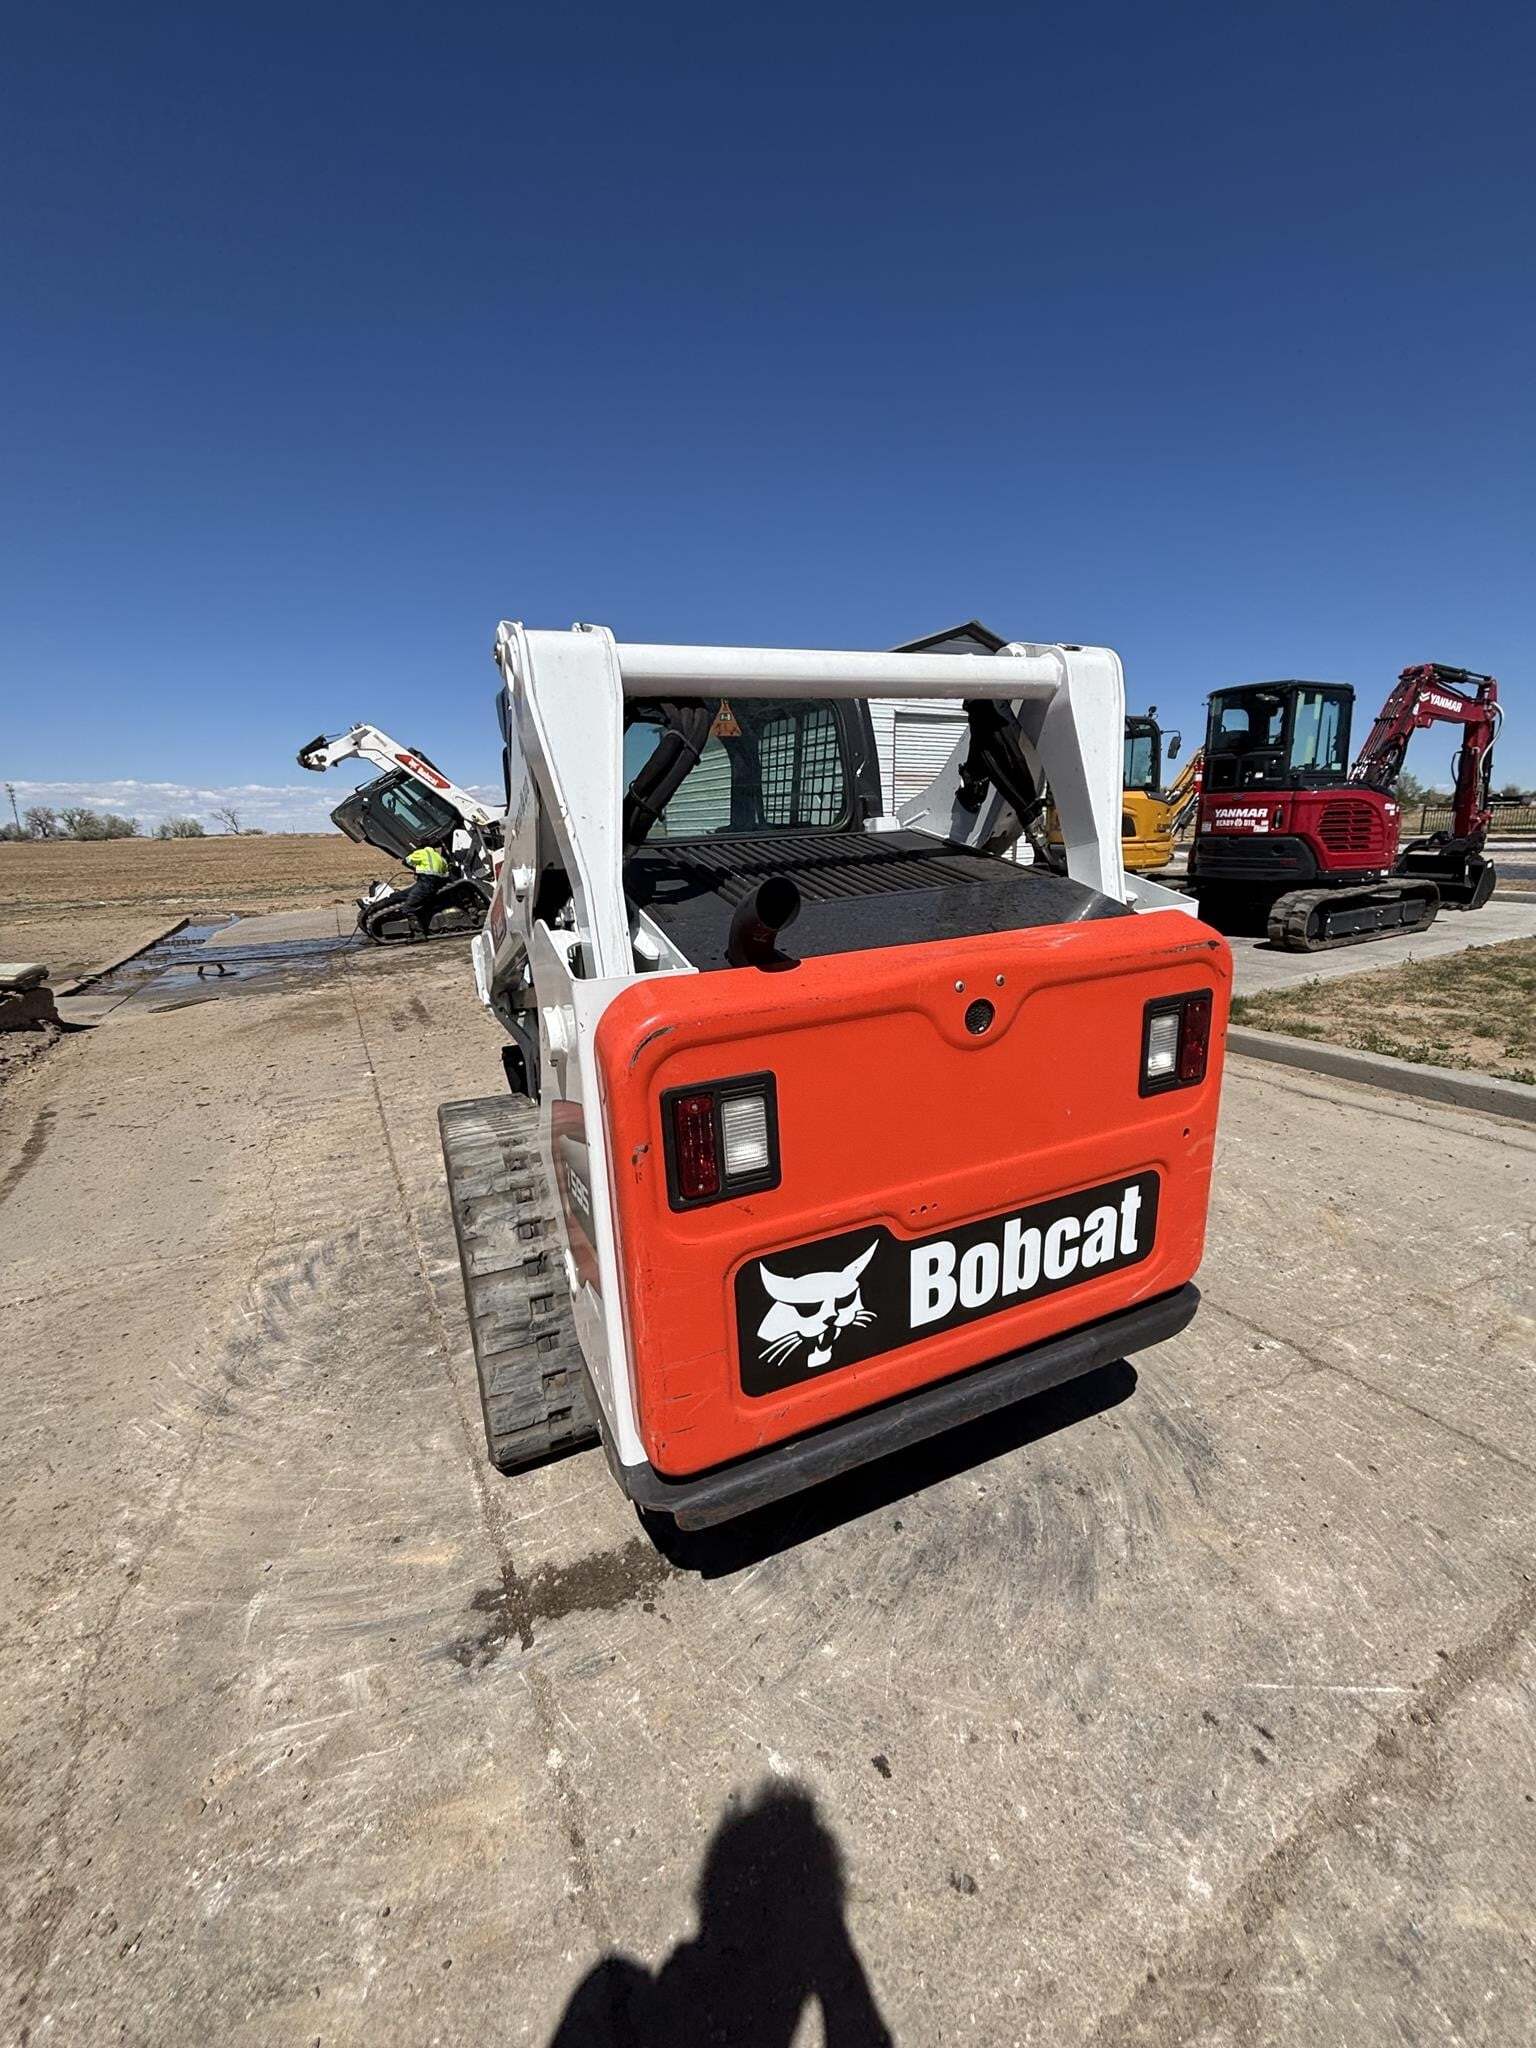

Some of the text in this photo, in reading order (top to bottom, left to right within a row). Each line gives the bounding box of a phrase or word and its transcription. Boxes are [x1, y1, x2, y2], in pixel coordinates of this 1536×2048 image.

[1431, 693, 1462, 713] YANMAR
[1215, 808, 1268, 818] YANMAR
[910, 1186, 1142, 1328] Bobcat
